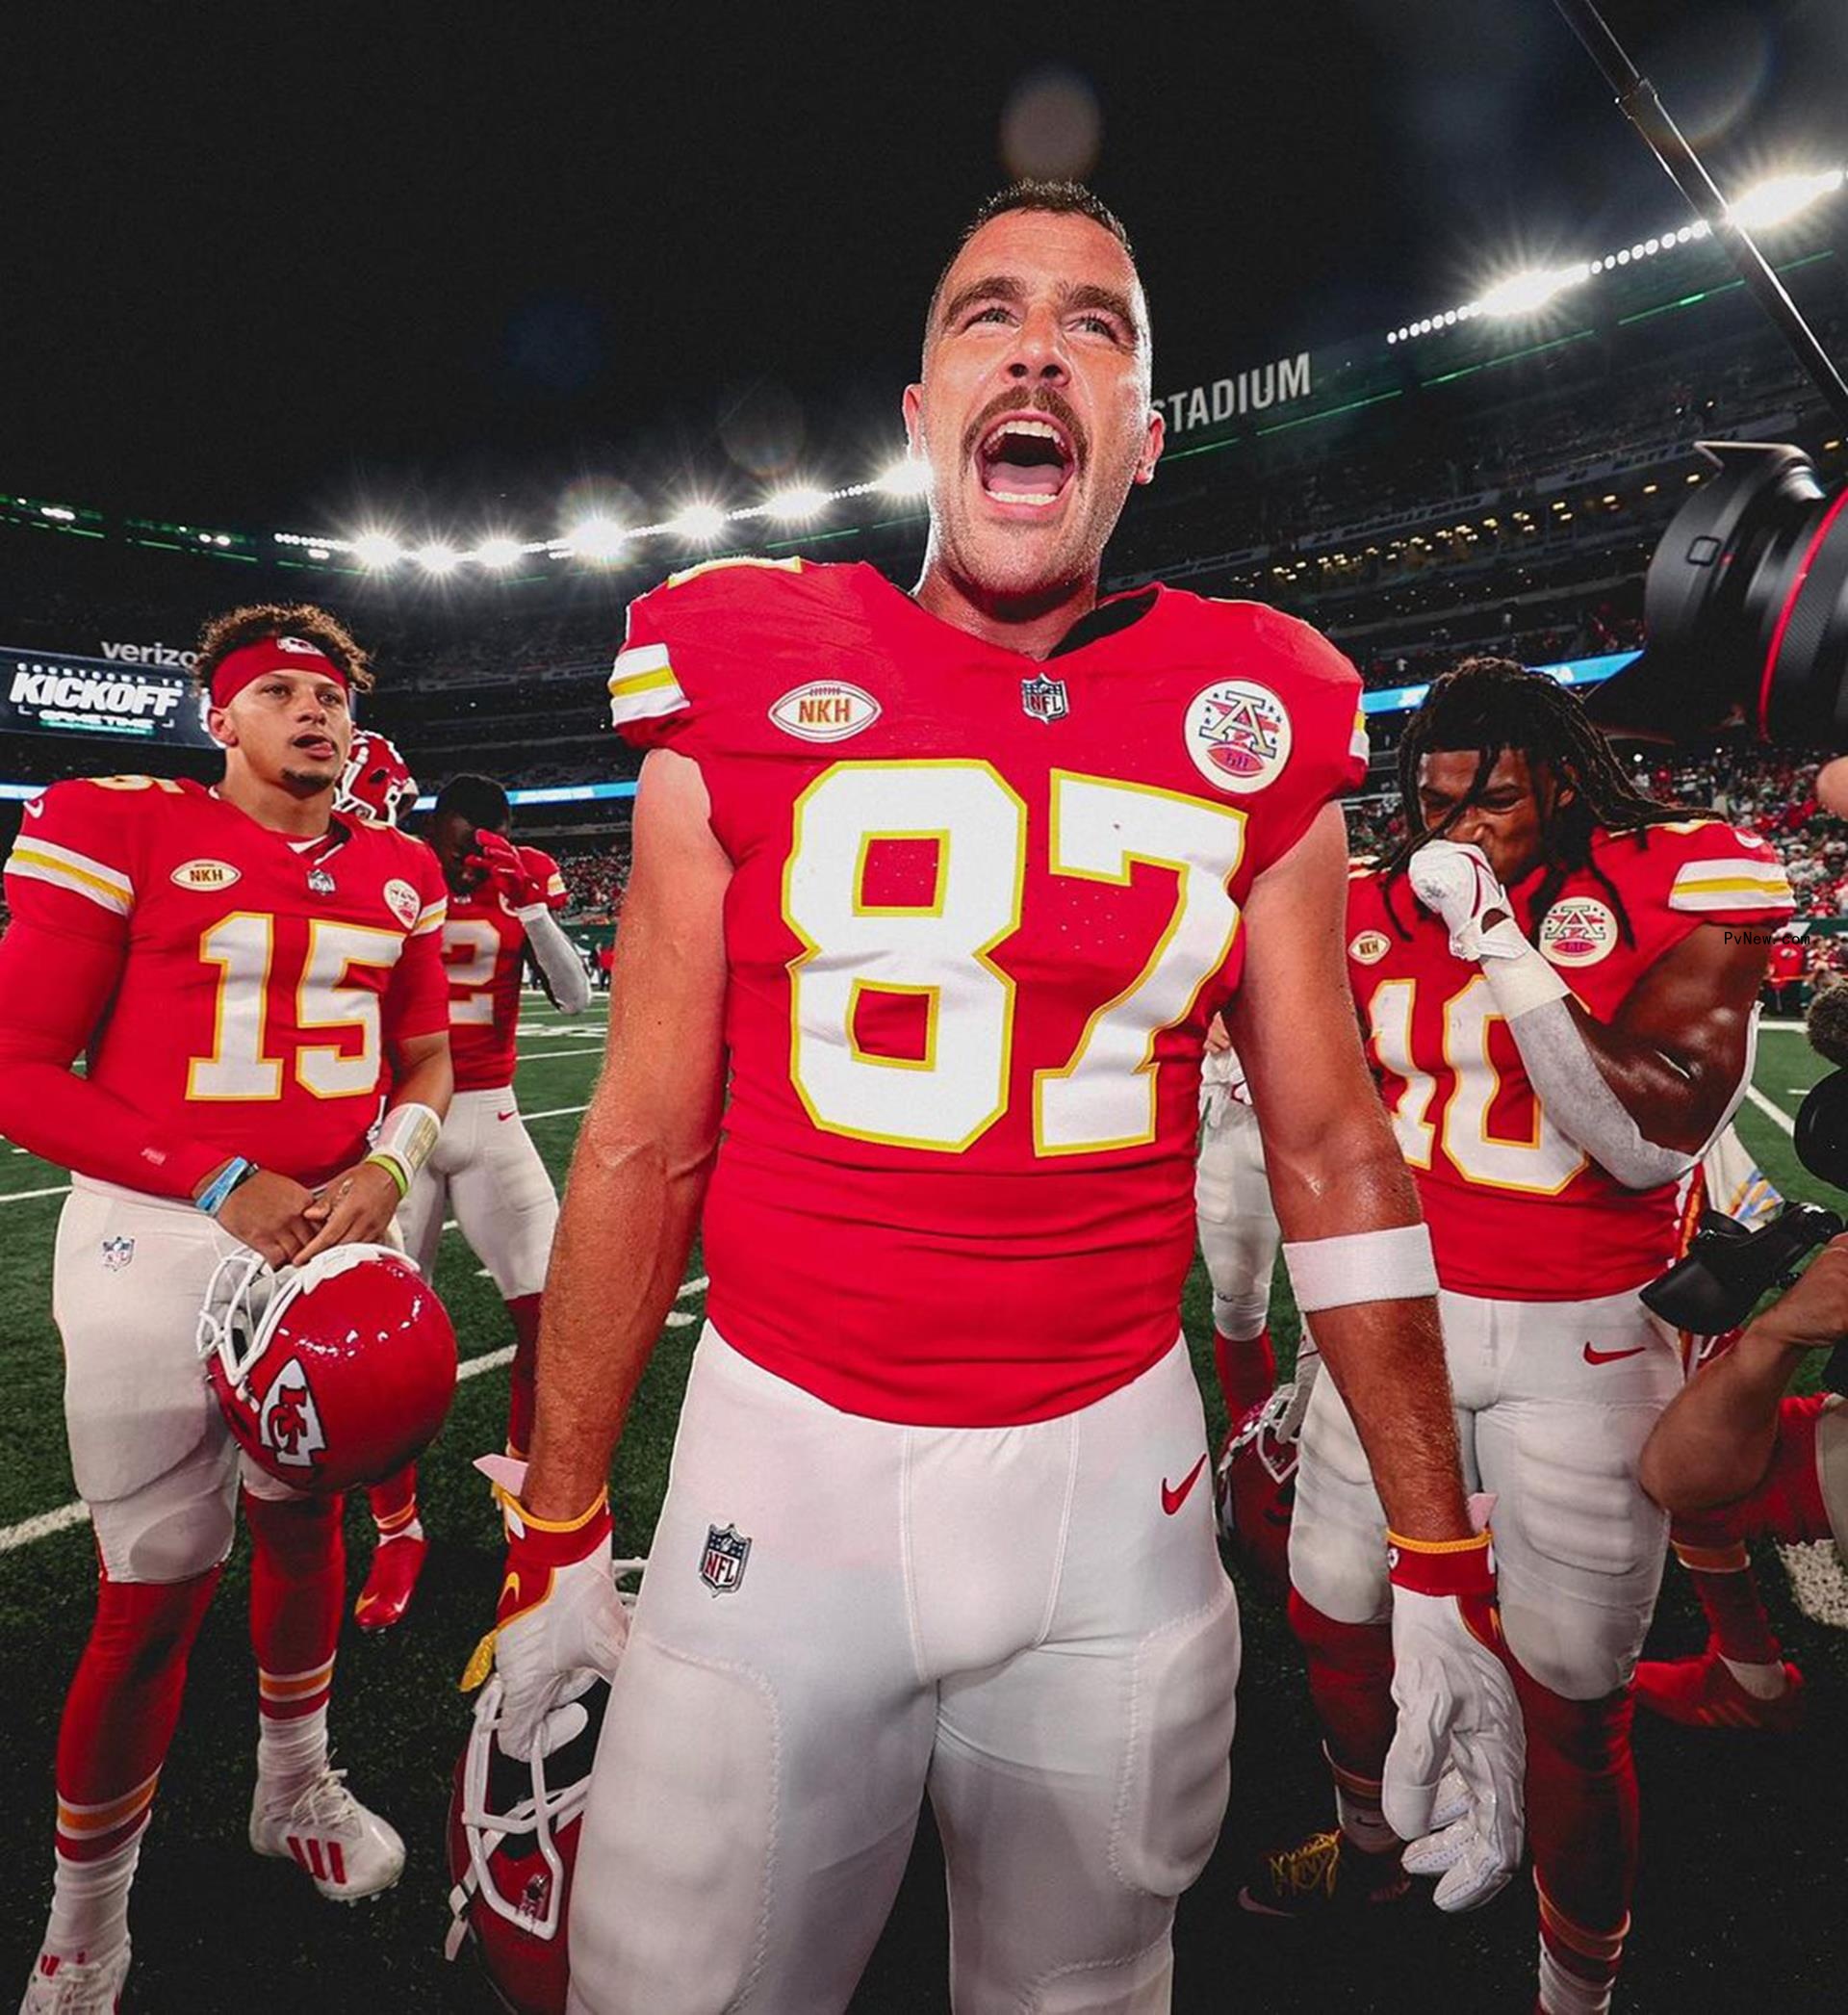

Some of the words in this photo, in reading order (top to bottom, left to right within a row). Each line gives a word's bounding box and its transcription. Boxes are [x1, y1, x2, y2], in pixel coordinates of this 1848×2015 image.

[100, 641, 197, 667] verizo
[9, 672, 184, 716] KICKOFF
[798, 699, 850, 723] NKH
[1030, 695, 1062, 714] NFL
[190, 868, 223, 882] NKH
[441, 919, 501, 1025] 2
[782, 758, 1248, 1157] 87
[184, 910, 409, 1100] 15
[1369, 974, 1591, 1196] 10
[705, 1551, 734, 1584] NFL
